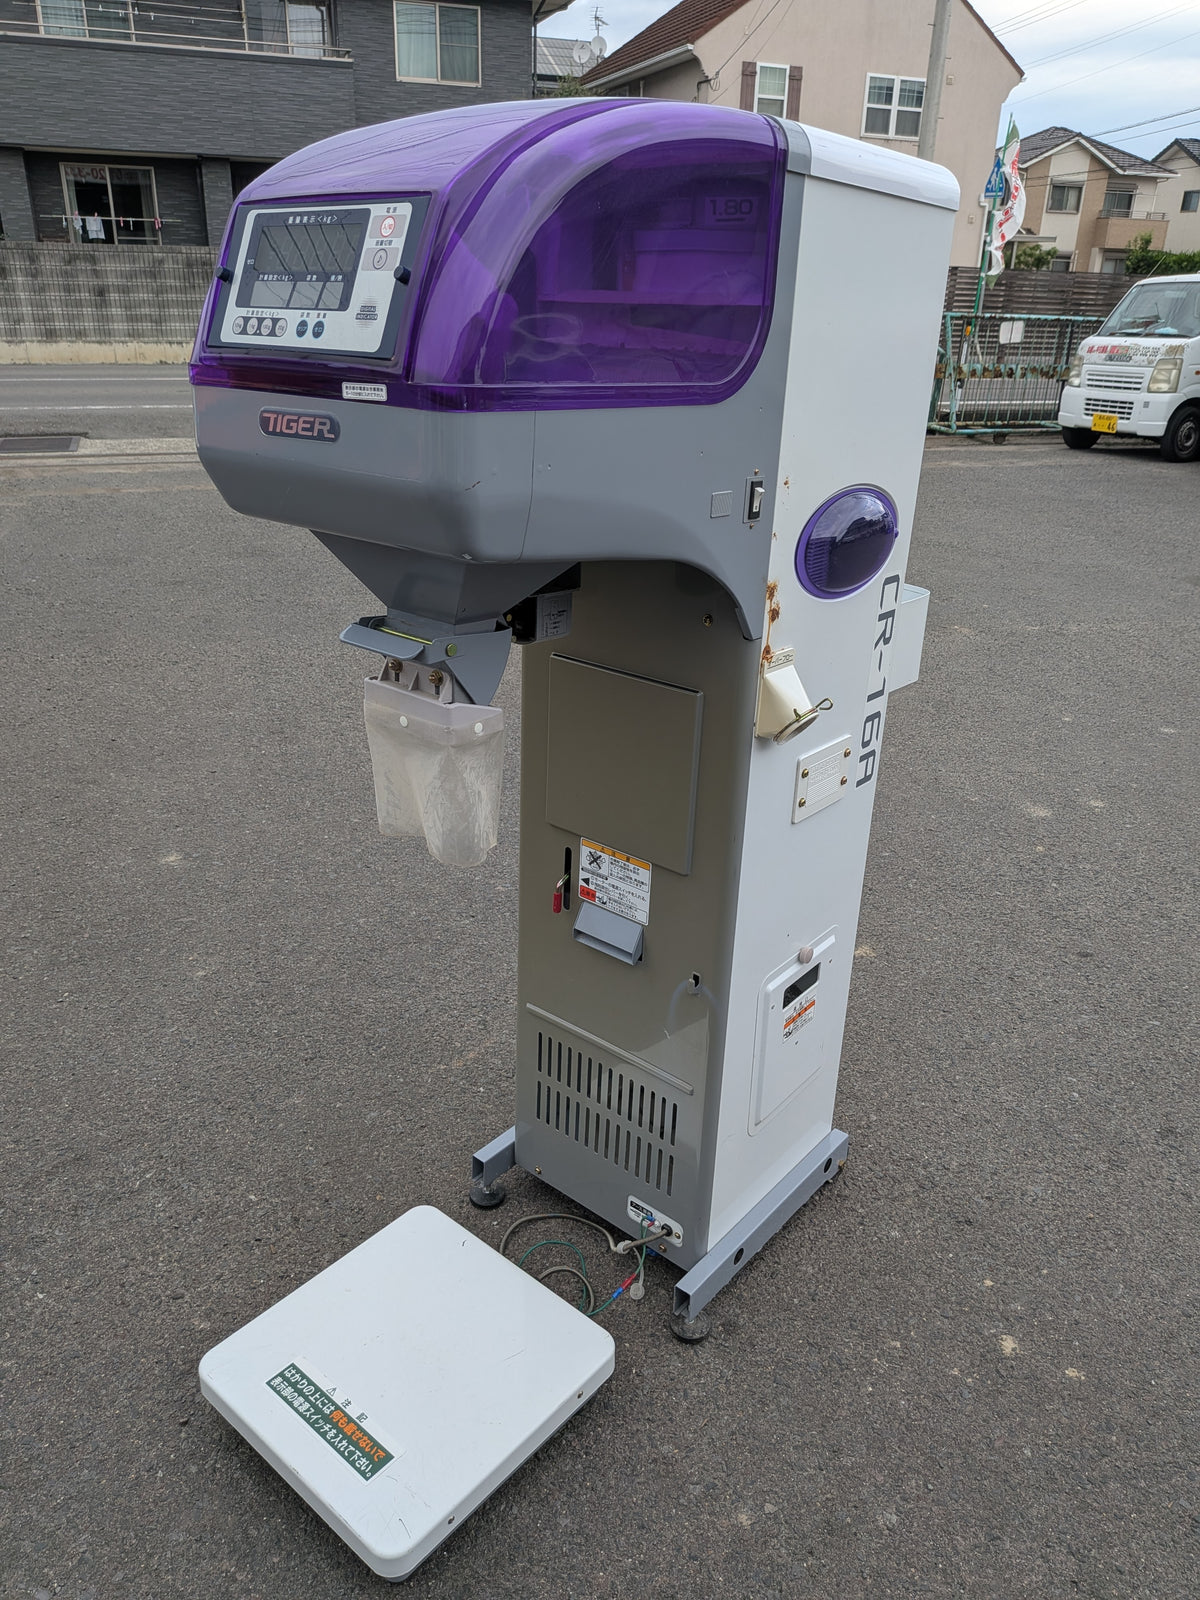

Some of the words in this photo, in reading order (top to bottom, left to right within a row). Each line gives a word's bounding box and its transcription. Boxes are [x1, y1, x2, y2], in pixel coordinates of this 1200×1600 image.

[710, 199, 753, 216] 1.80
[355, 313, 378, 321] INDICATOR
[262, 412, 335, 438] TIGER
[855, 574, 900, 788] CR-16A
[270, 1376, 372, 1478] 表示部の電源スイッチを入れて下さい。
